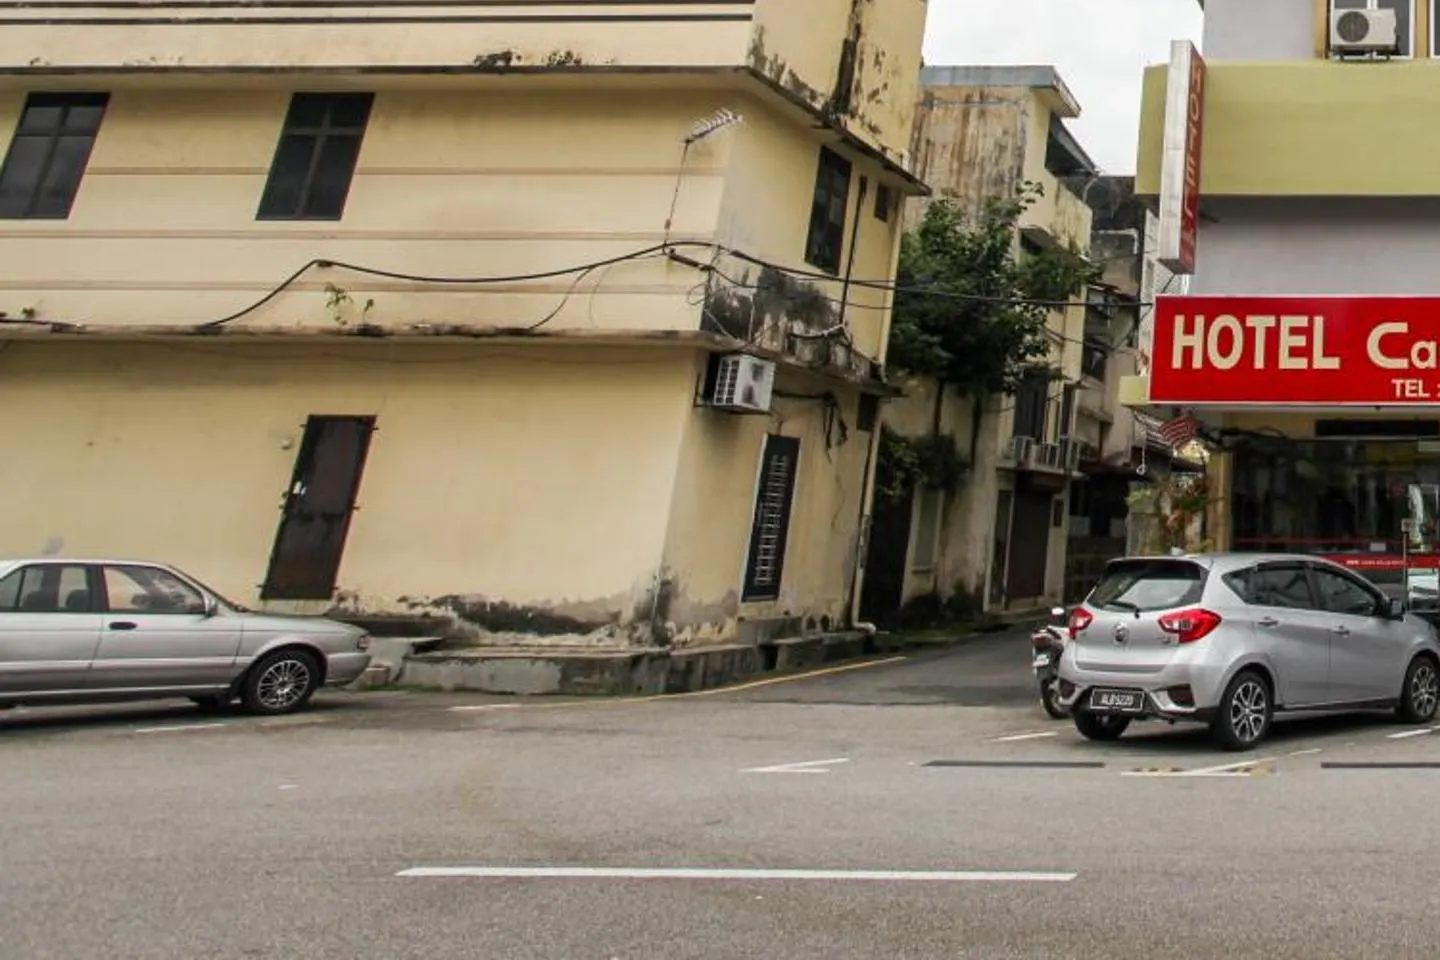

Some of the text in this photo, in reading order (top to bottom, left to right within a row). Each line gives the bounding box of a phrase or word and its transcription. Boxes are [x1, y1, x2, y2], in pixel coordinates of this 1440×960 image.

[1184, 58, 1203, 218] HOTEL
[1171, 314, 1341, 370] HOTEL
[1392, 378, 1431, 399] TEL
